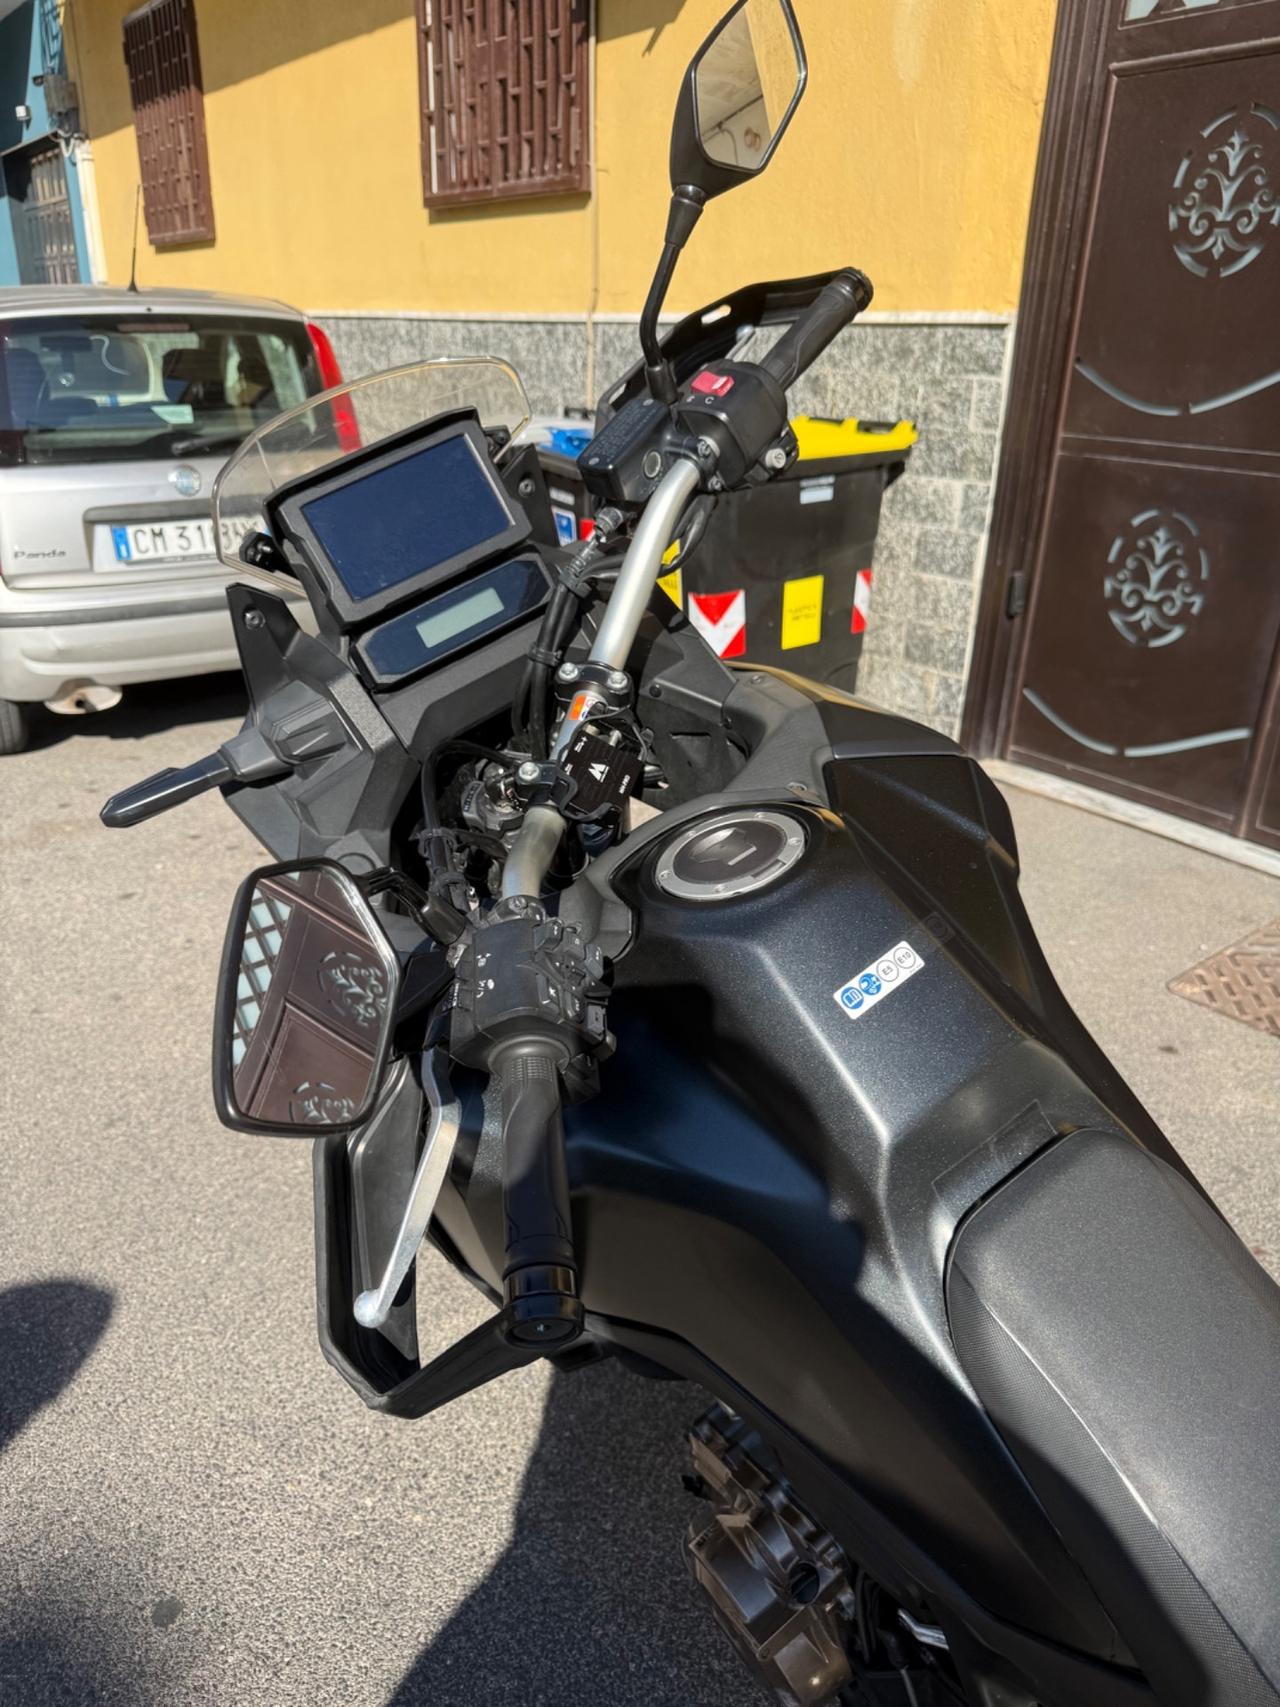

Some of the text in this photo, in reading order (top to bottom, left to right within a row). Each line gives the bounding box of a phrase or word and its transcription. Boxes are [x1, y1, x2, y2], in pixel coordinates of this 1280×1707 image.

[134, 527, 168, 554] CM
[14, 549, 66, 560] Panda
[897, 951, 912, 964] E10
[881, 965, 894, 976] E5
